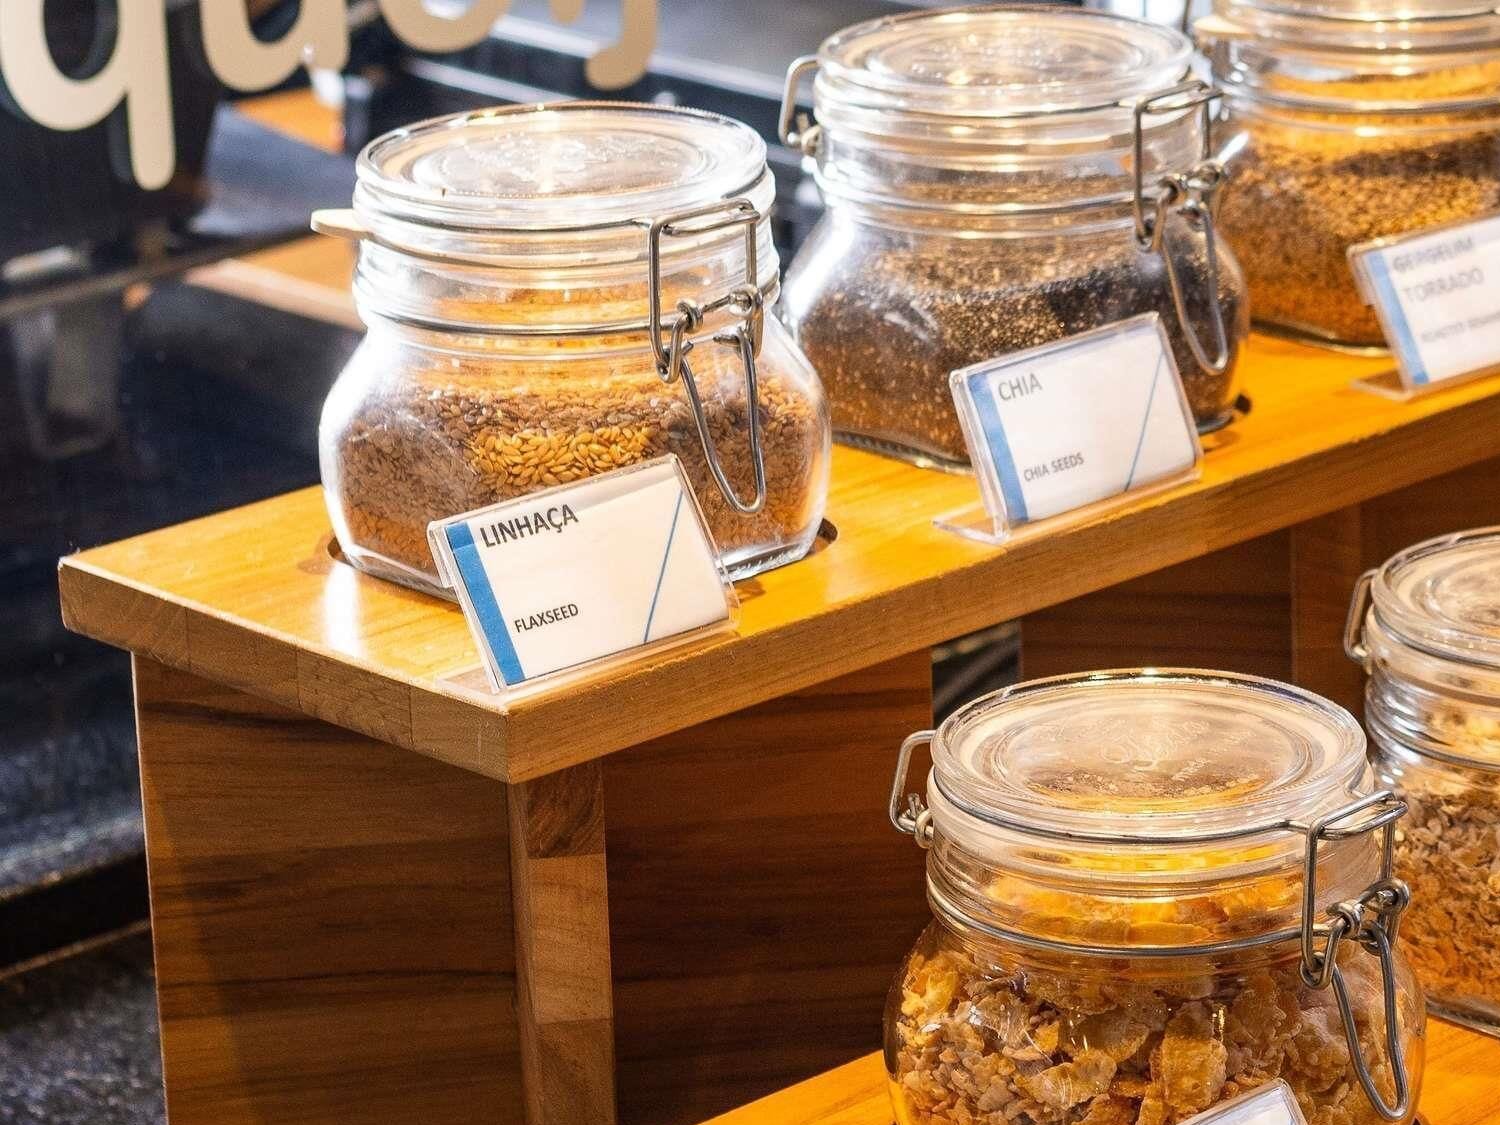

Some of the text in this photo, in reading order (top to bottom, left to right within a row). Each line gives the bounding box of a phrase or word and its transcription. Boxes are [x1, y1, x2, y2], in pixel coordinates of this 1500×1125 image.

[998, 373, 1043, 401] CHIA
[1024, 452, 1085, 482] CHIA SEEDS
[480, 503, 579, 548] LINHAÇA
[514, 603, 579, 633] FLAXSEED
